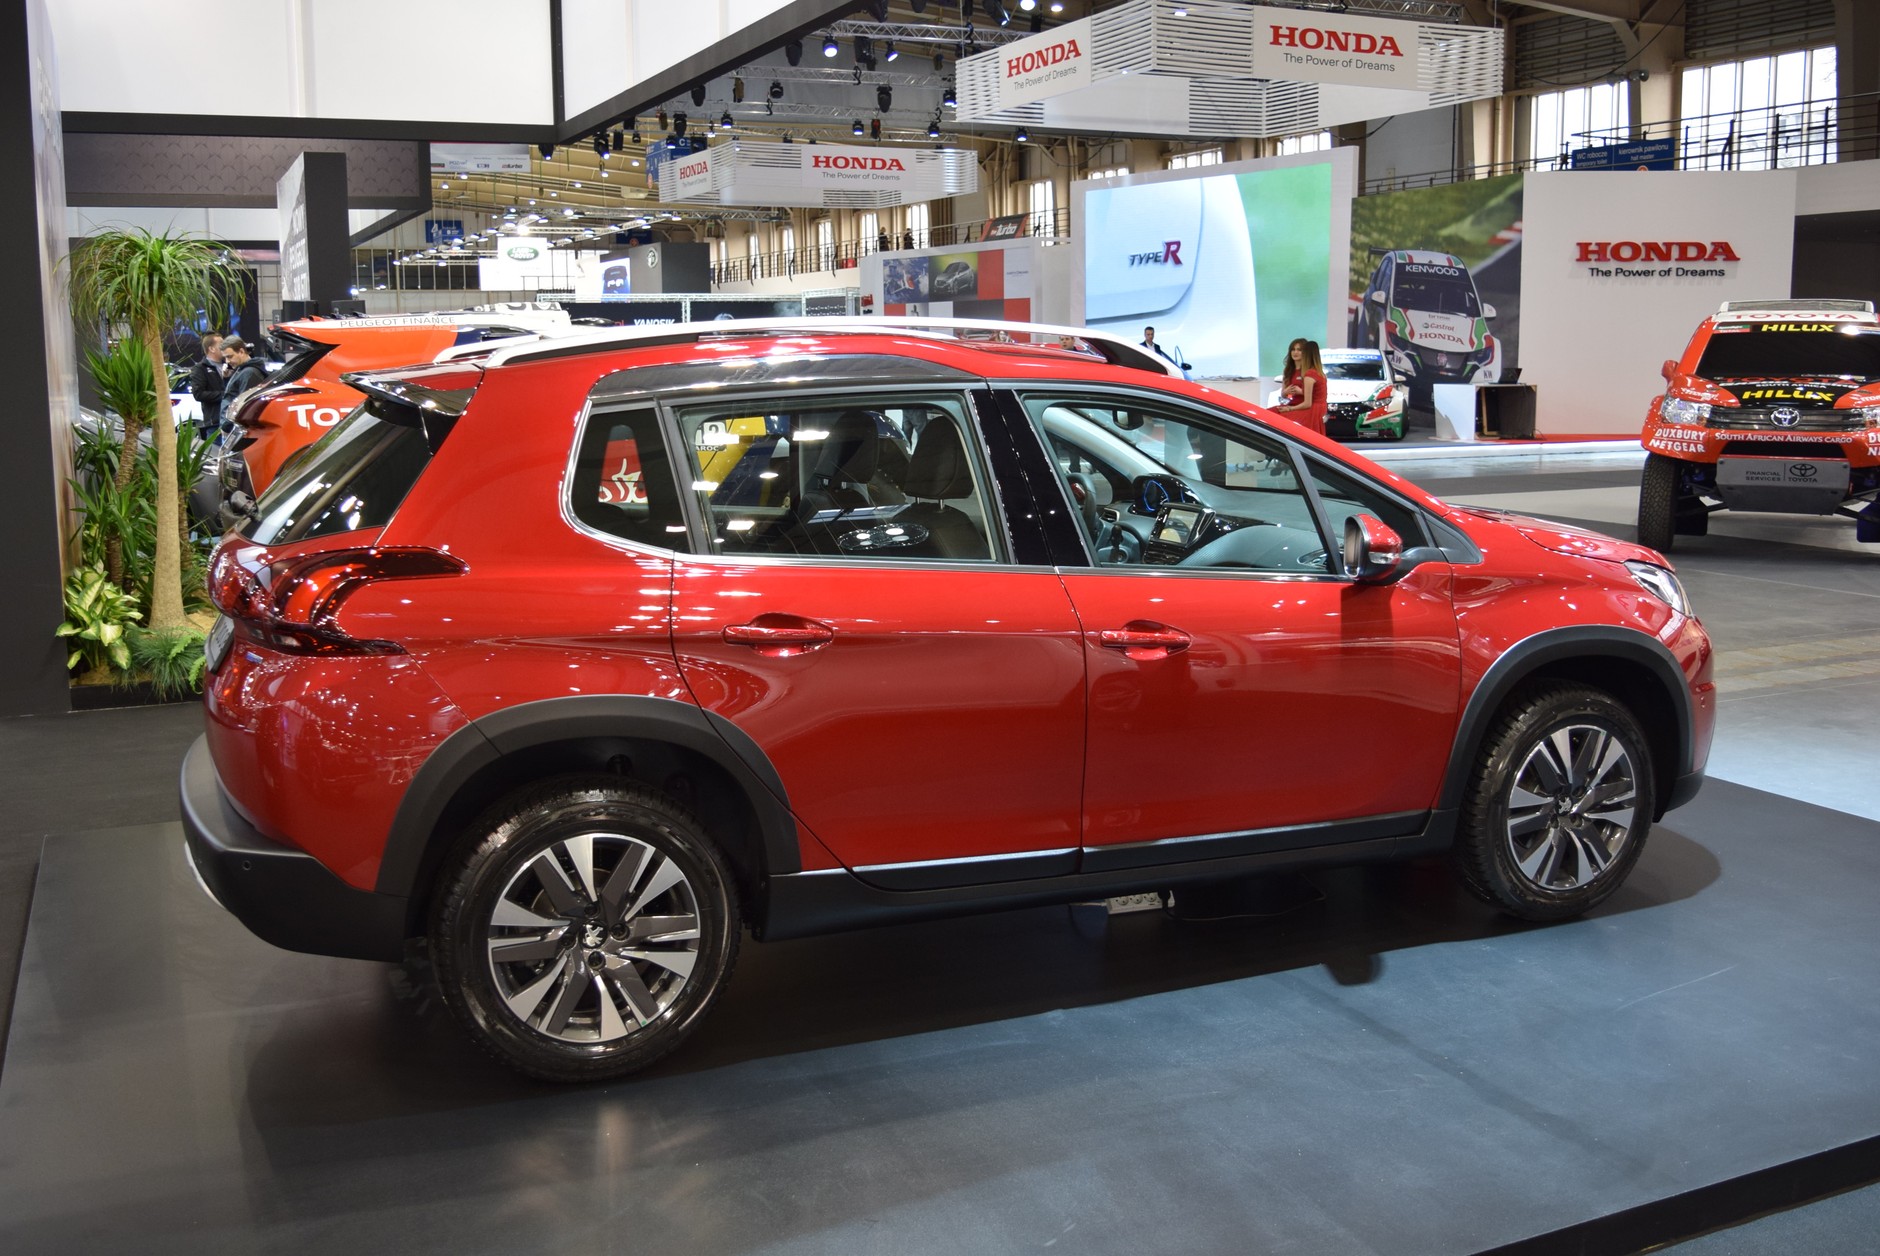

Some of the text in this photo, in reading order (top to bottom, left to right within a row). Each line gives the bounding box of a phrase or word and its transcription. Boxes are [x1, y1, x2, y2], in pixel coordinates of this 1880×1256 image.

[1268, 25, 1404, 57] HONDA
[1007, 39, 1082, 78] HONDA
[1283, 52, 1396, 72] The Power of Dreams
[1014, 66, 1077, 91] The Power of Dreams
[679, 160, 708, 180] HONDA
[811, 155, 906, 171] HONDA
[822, 171, 836, 179] The
[837, 172, 861, 180] Power
[872, 173, 900, 181] Dreams
[1130, 240, 1183, 266] TYPE R
[1575, 241, 1741, 262] HONDA
[1405, 264, 1459, 276] KENWOOD
[1588, 267, 1725, 277] The Power of Dreams
[340, 316, 455, 328] PEUGEOT FINANCE
[1430, 322, 1455, 332] Castrol
[1761, 324, 1836, 332] HILUX
[1418, 332, 1465, 346] HONDA
[1742, 390, 1835, 402] HILUX
[288, 404, 354, 427] TO
[1655, 428, 1706, 441] DUXBURY
[1715, 432, 1744, 440] SOUTH
[1746, 433, 1784, 442] AFRICAN
[1785, 434, 1822, 442] AIRWAYS
[1649, 439, 1706, 453] NETGEAR
